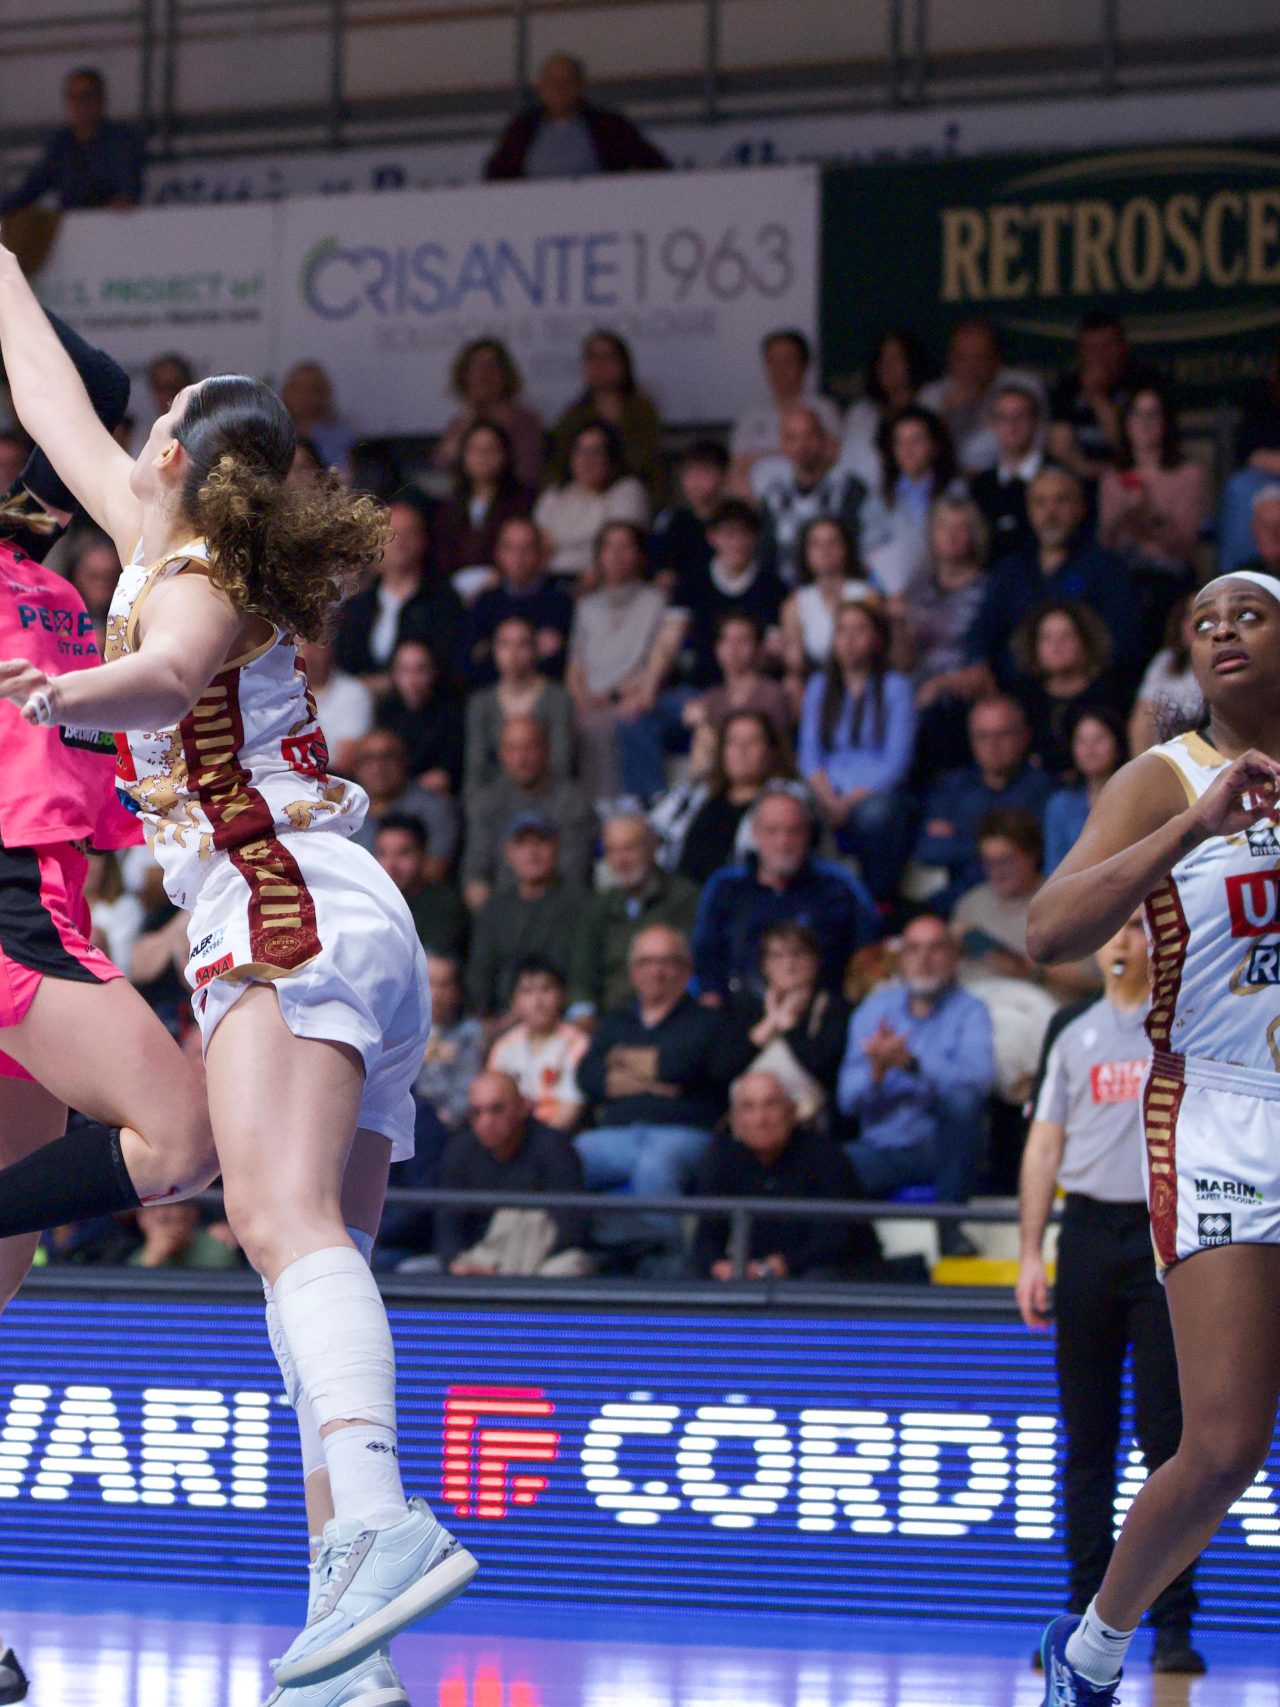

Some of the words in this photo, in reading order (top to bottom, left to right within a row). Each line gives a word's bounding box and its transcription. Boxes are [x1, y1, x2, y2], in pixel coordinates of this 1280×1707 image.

[940, 189, 1280, 301] RETROSCE
[1240, 879, 1280, 927] U
[198, 960, 230, 982] ANA
[1251, 954, 1280, 983] R
[1194, 1179, 1256, 1198] MARIN
